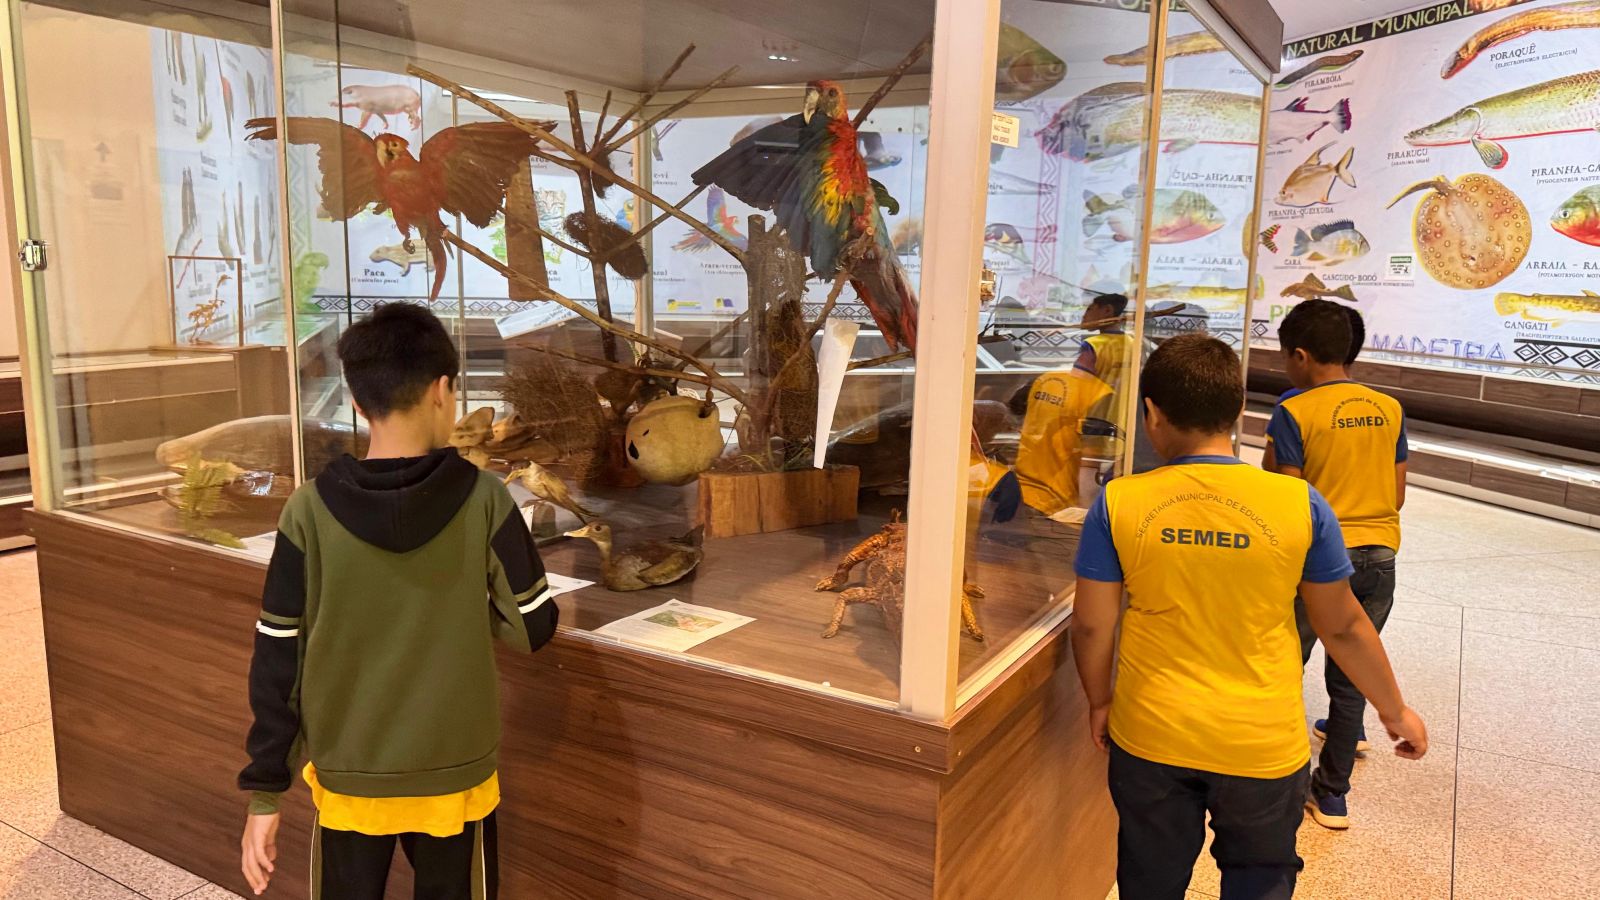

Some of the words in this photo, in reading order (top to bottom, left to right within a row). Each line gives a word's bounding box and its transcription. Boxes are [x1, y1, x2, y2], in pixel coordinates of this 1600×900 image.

[1287, 25, 1363, 57] NATURAL
[1372, 0, 1474, 37] MUNICIPAL
[1490, 43, 1536, 61] PORAQUÊ
[364, 268, 385, 276] Paca
[1525, 261, 1567, 270] ARRAIA
[1504, 320, 1549, 332] CANGATI
[1337, 416, 1384, 429] SEMED
[1136, 498, 1175, 539] SECRETARIA
[1175, 492, 1224, 504] MUNICIPAL
[1225, 498, 1239, 510] DE
[1160, 527, 1250, 549] SEMED
